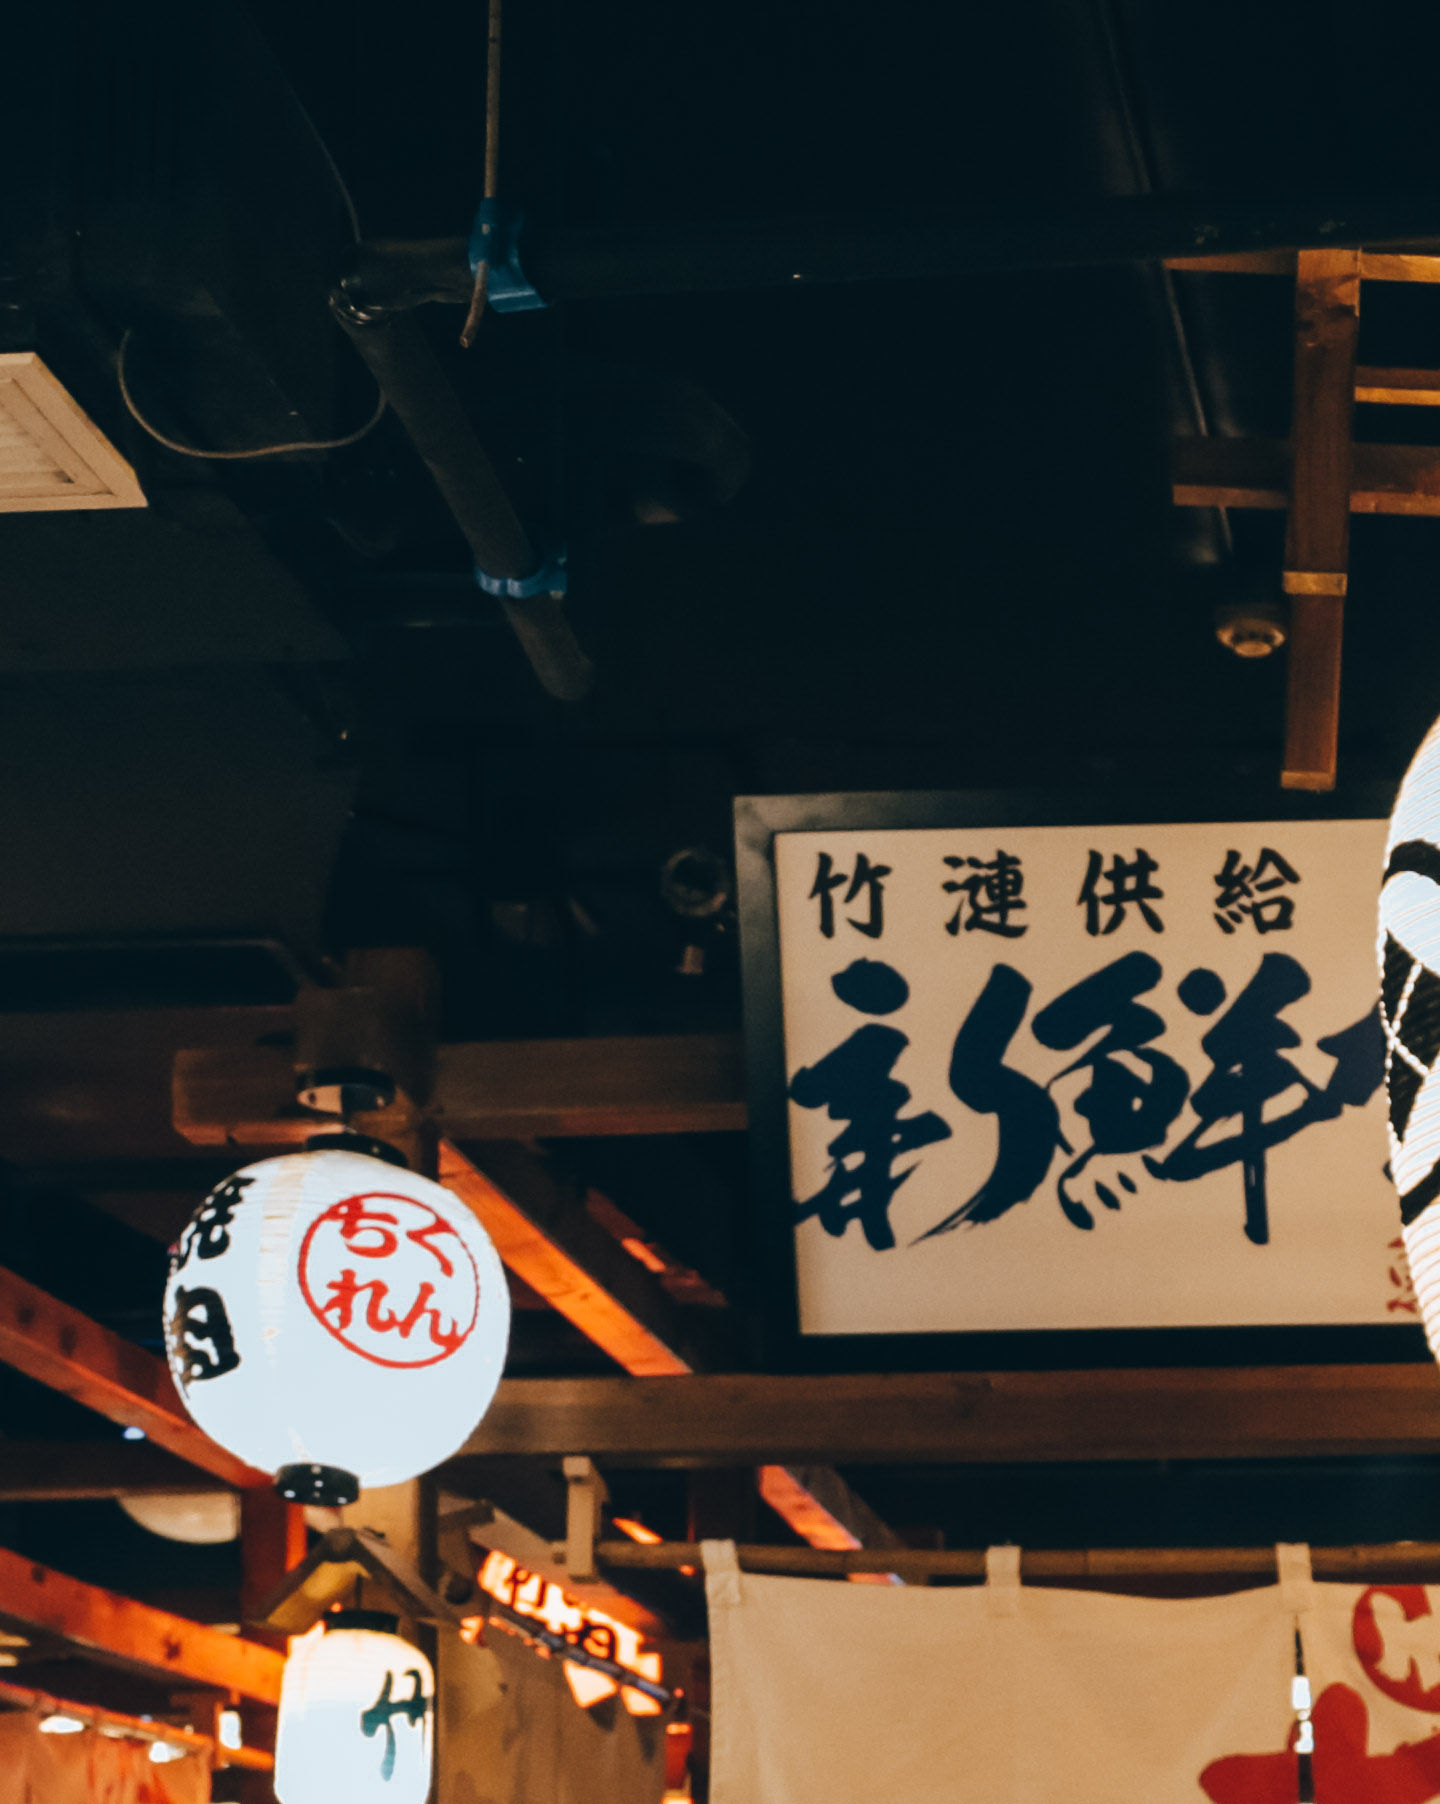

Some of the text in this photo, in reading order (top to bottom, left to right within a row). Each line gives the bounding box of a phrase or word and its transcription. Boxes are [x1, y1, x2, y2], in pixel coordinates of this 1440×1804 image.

[809, 847, 1301, 938] 竹漣供給
[328, 1198, 456, 1278] ちく
[322, 1268, 462, 1350] れん
